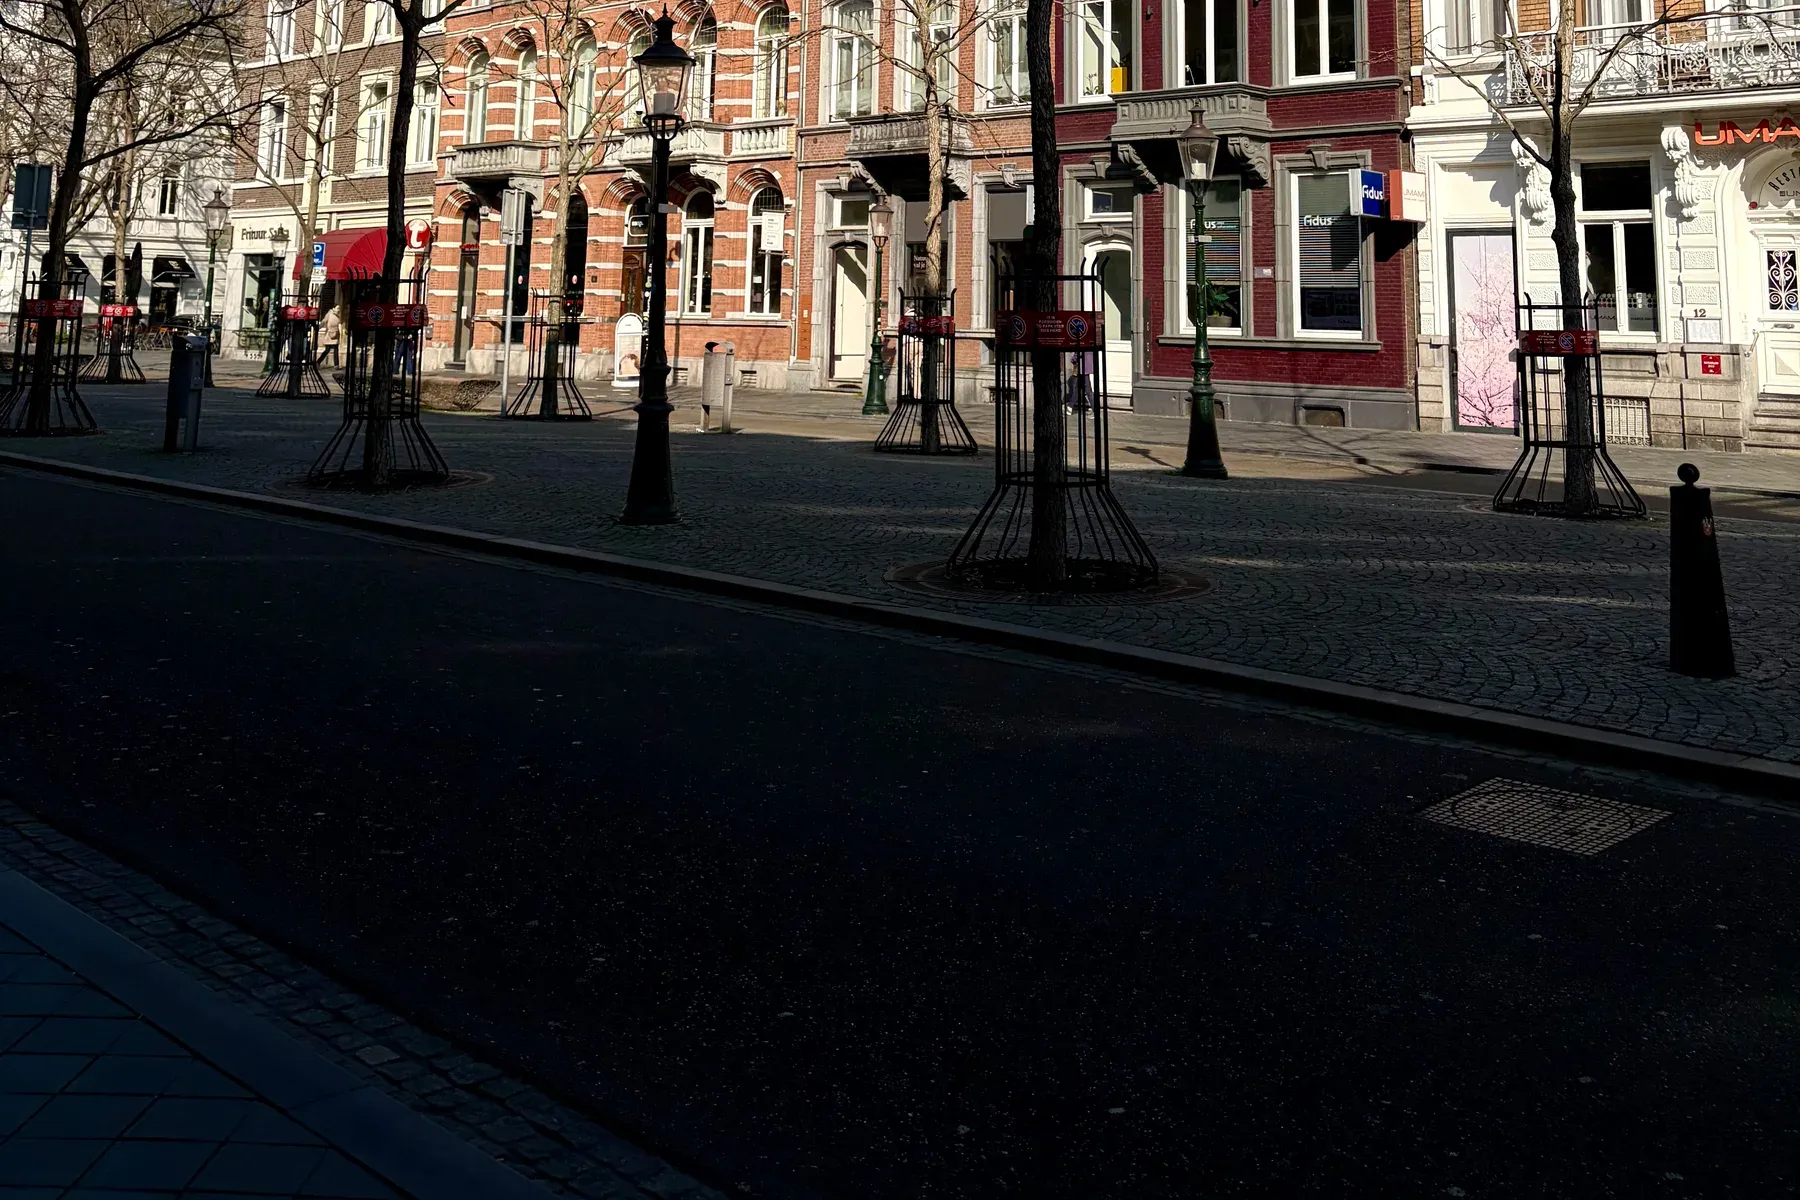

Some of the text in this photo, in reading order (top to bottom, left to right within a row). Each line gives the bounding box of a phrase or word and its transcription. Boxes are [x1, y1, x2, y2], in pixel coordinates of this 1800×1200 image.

[1768, 166, 1800, 191] REST
[1362, 185, 1384, 200] Fidus
[1190, 219, 1217, 229] Fus
[1304, 215, 1333, 226] Fidus
[1694, 308, 1706, 317] 12
